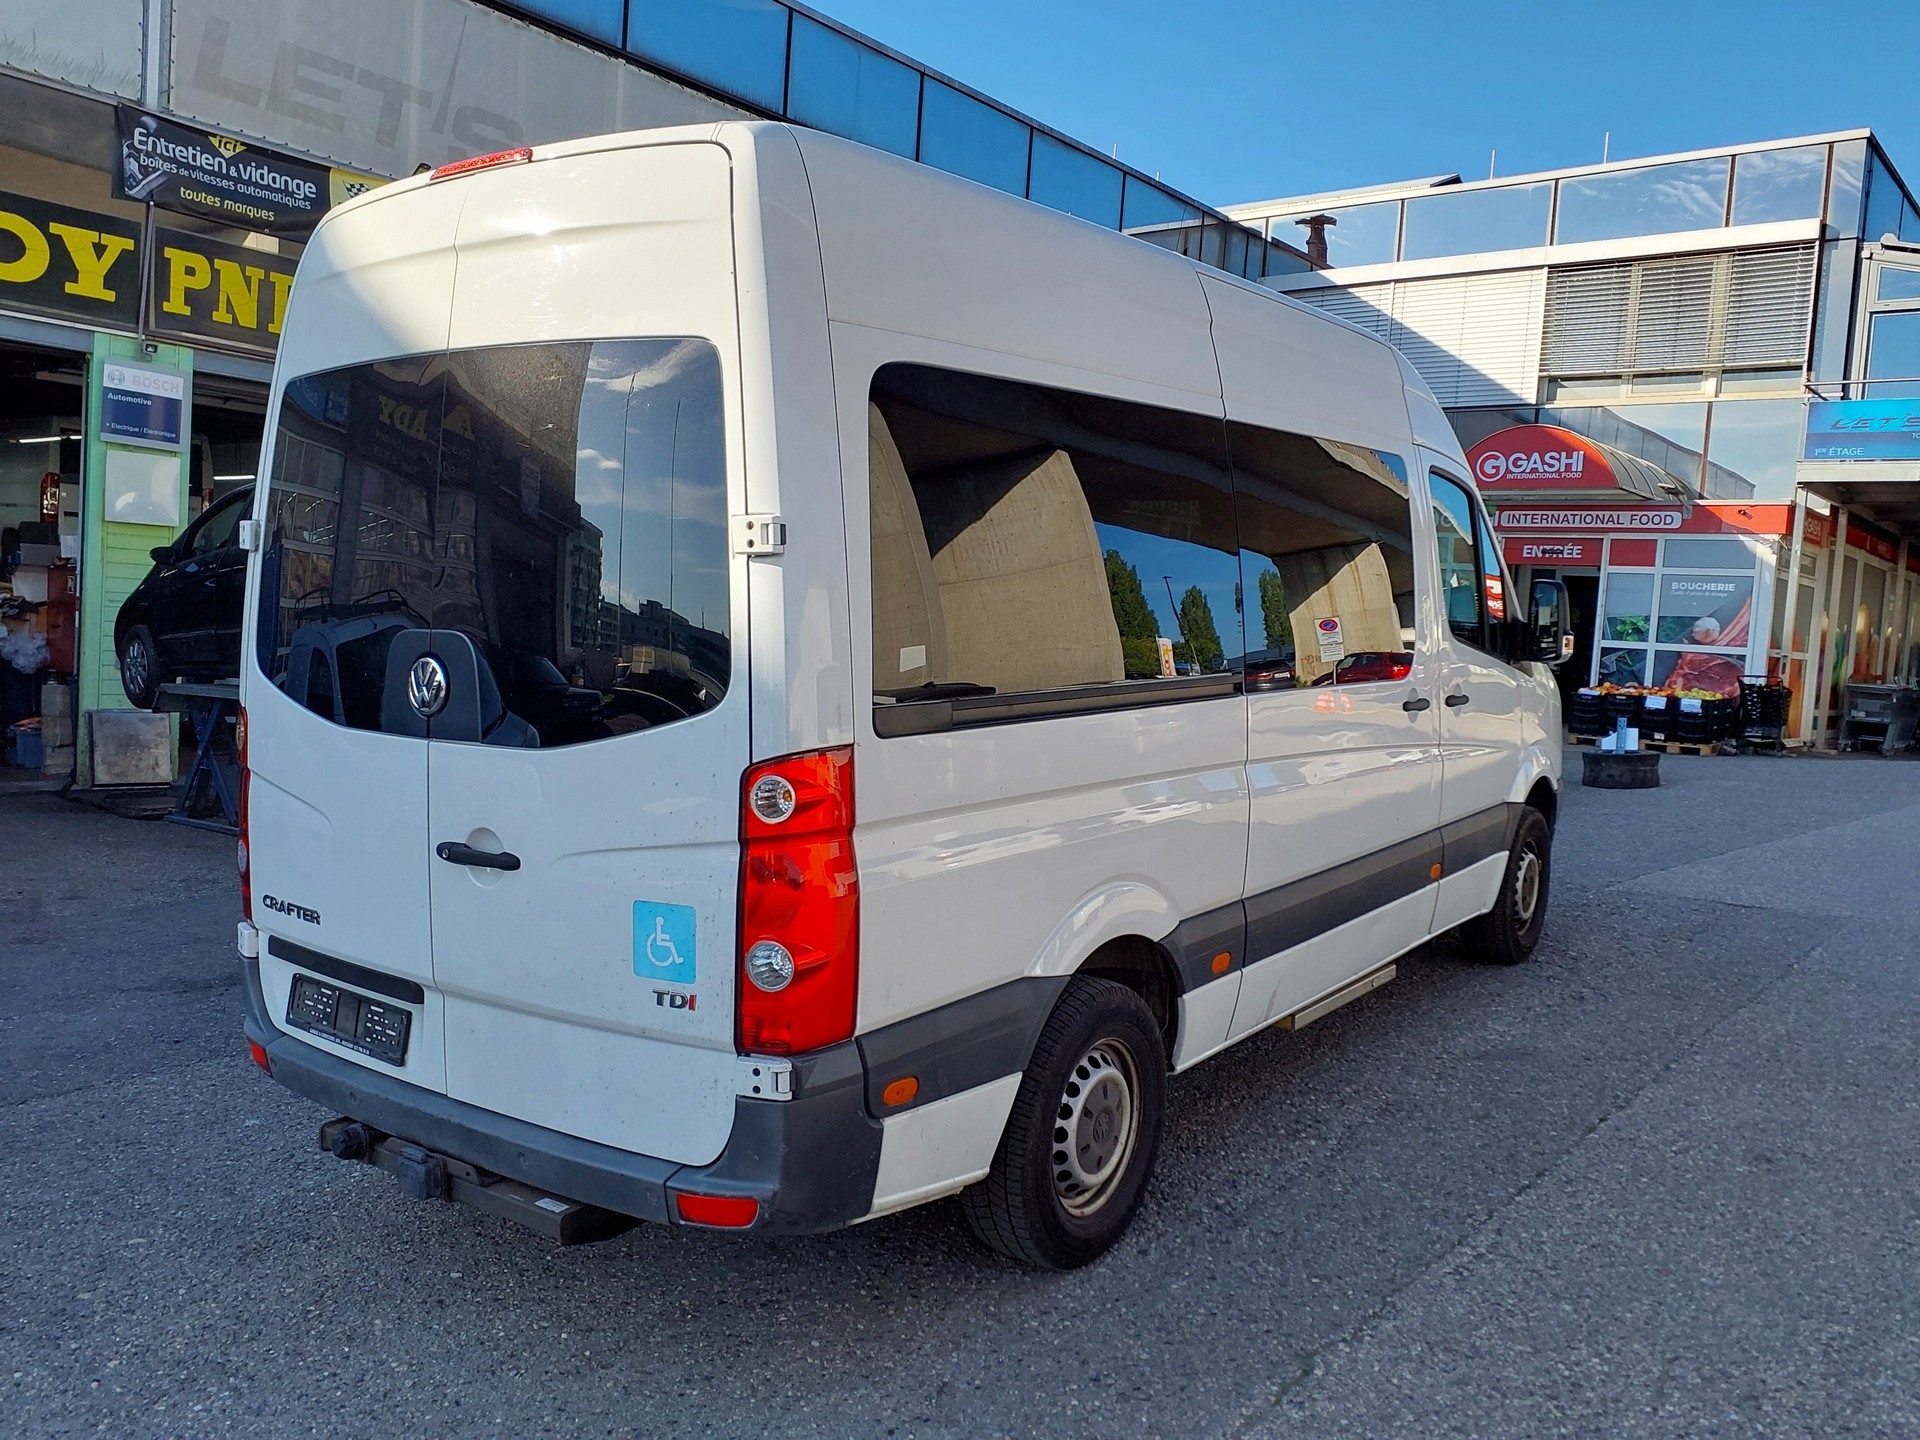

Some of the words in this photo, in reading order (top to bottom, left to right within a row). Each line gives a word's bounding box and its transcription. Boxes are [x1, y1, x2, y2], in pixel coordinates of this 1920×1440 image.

[133, 127, 227, 175] Entretien
[229, 166, 238, 178] &
[216, 135, 238, 153] ici
[139, 152, 178, 174] boîtes
[178, 168, 189, 177] de
[237, 182, 311, 211] automatiques
[180, 186, 221, 207] toutes
[224, 199, 275, 222] marques
[132, 374, 180, 394] BOSCH
[107, 392, 152, 406] Automotive
[111, 422, 140, 433] Electrique
[143, 427, 176, 438] Electronique
[1829, 446, 1865, 456] ÉTAGE
[1507, 450, 1584, 472] GASHI
[1506, 472, 1560, 480] INTERNATIONAL
[1506, 513, 1625, 526] INTERNATIONAL
[1629, 513, 1675, 526] FOOD
[1671, 581, 1736, 591] BOUCHERIE
[262, 894, 321, 926] CRAFTER
[652, 988, 697, 1012] TDI
